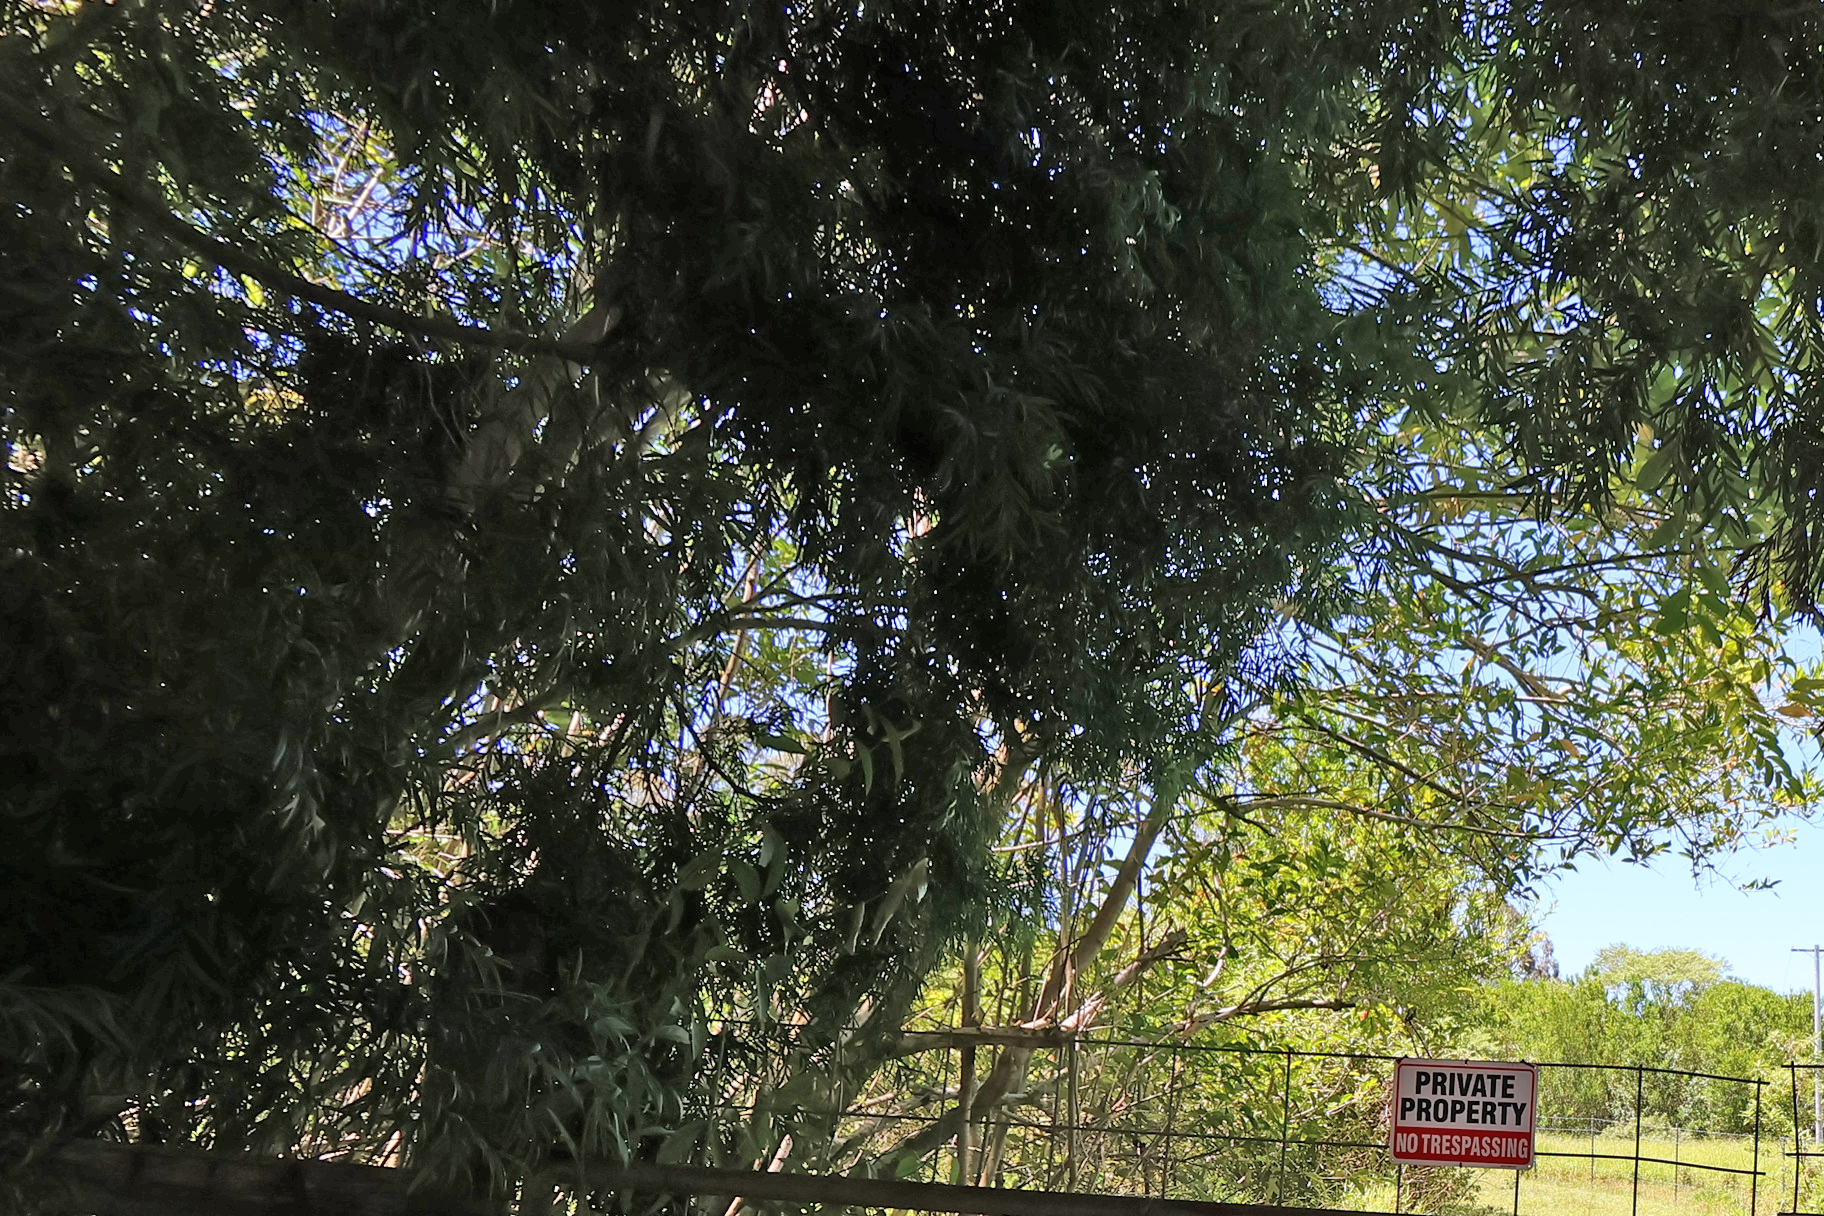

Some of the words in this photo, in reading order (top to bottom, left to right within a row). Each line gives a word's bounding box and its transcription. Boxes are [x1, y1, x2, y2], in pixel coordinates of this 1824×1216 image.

[1415, 1071, 1516, 1098] PRIVATE
[1400, 1097, 1527, 1126] PROPERTY
[1396, 1133, 1418, 1153] NO
[1422, 1134, 1528, 1159] TRESPASSING
